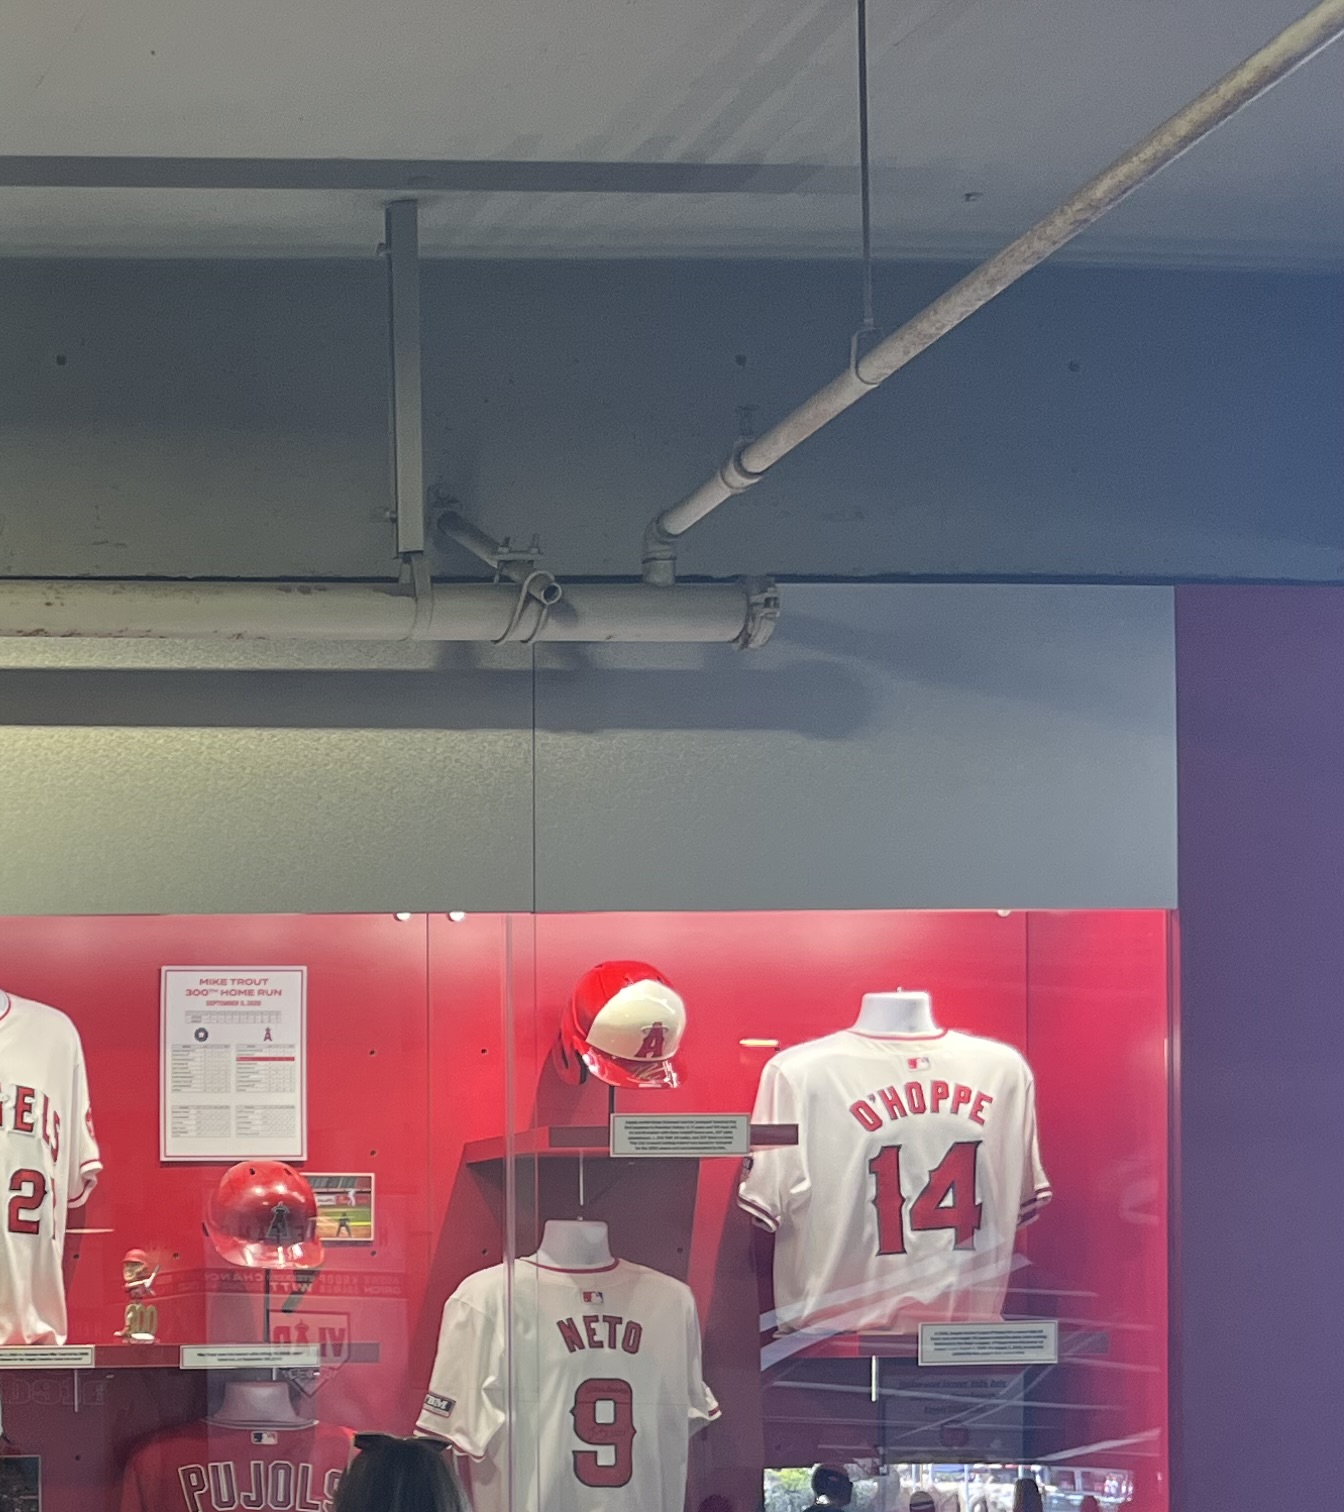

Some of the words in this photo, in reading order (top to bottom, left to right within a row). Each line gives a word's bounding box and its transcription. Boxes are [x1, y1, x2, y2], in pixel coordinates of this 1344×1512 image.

[199, 978, 228, 986] MIKE
[229, 978, 269, 986] TROUT
[220, 989, 255, 997] HOME
[257, 989, 283, 997] RUN
[634, 1021, 670, 1059] A
[849, 1080, 994, 1132] O'HOPPE
[8, 1168, 57, 1240] 2
[869, 1140, 984, 1257] 14
[557, 1314, 643, 1355] NETO
[569, 1378, 638, 1488] 9
